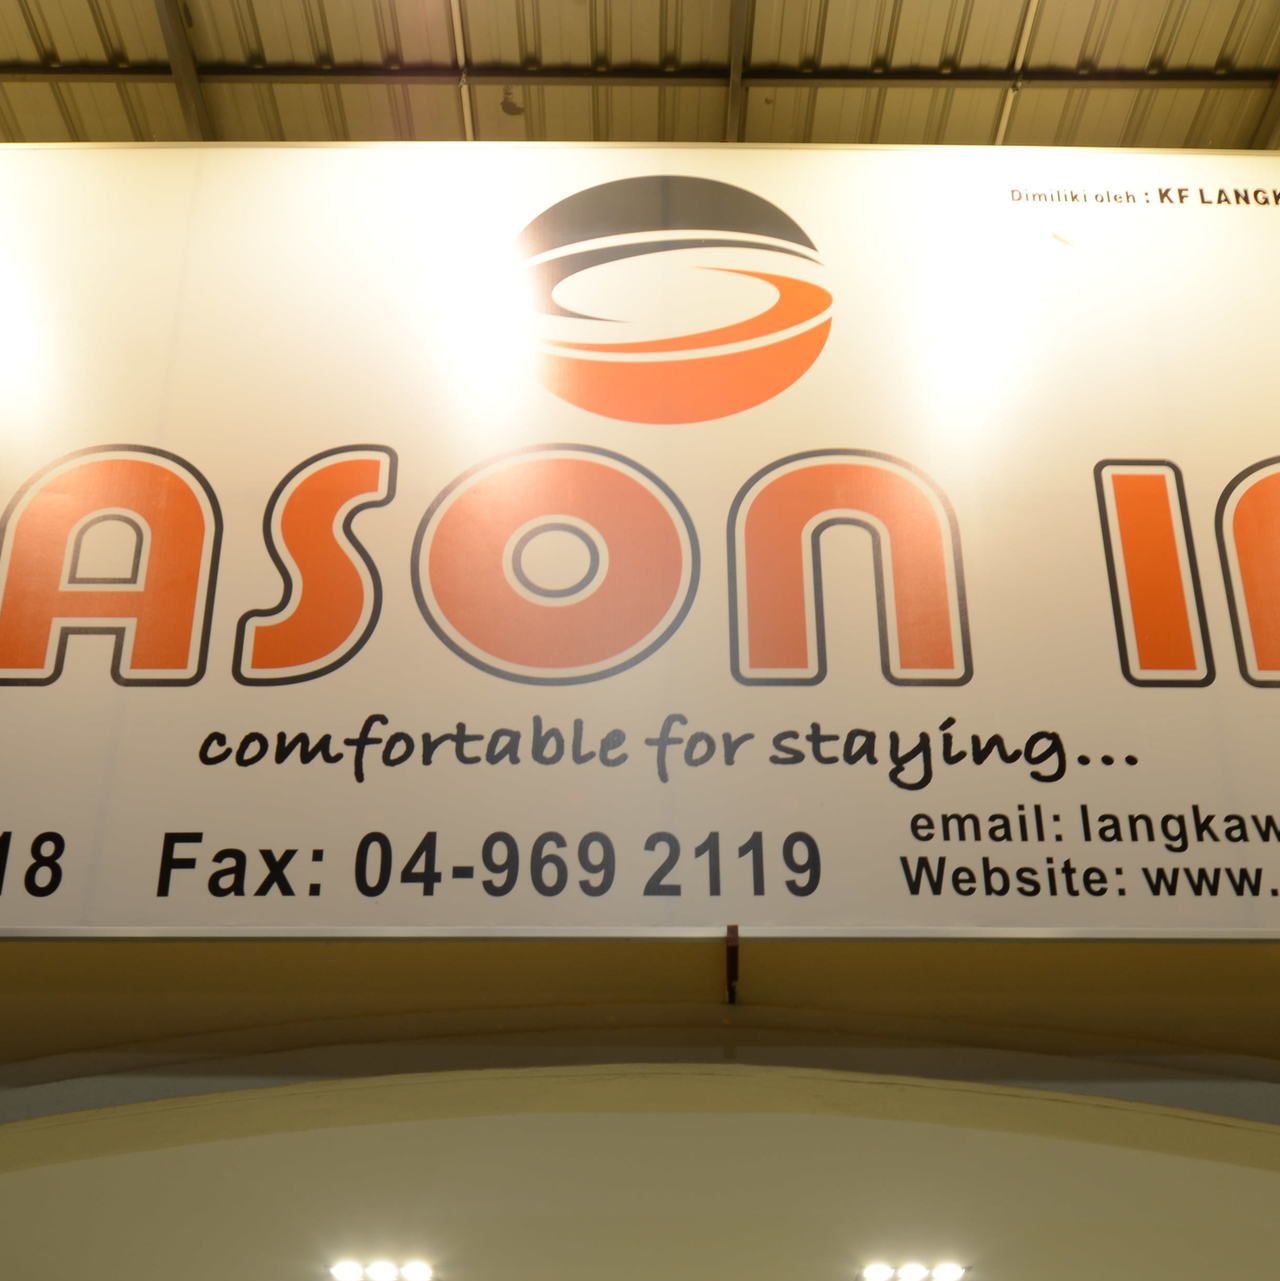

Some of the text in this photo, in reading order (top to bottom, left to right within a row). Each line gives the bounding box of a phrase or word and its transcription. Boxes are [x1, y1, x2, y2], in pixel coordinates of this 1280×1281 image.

[1010, 187, 1088, 204] Dimiliki
[1094, 188, 1137, 204] oleh
[1157, 187, 1190, 205] KF
[198, 713, 1140, 791] comfortable for staying...
[910, 804, 1064, 843] email:
[156, 831, 325, 898] Fax:
[354, 831, 616, 898] 04-969
[643, 831, 822, 898] 2119
[900, 855, 1127, 898] Website:
